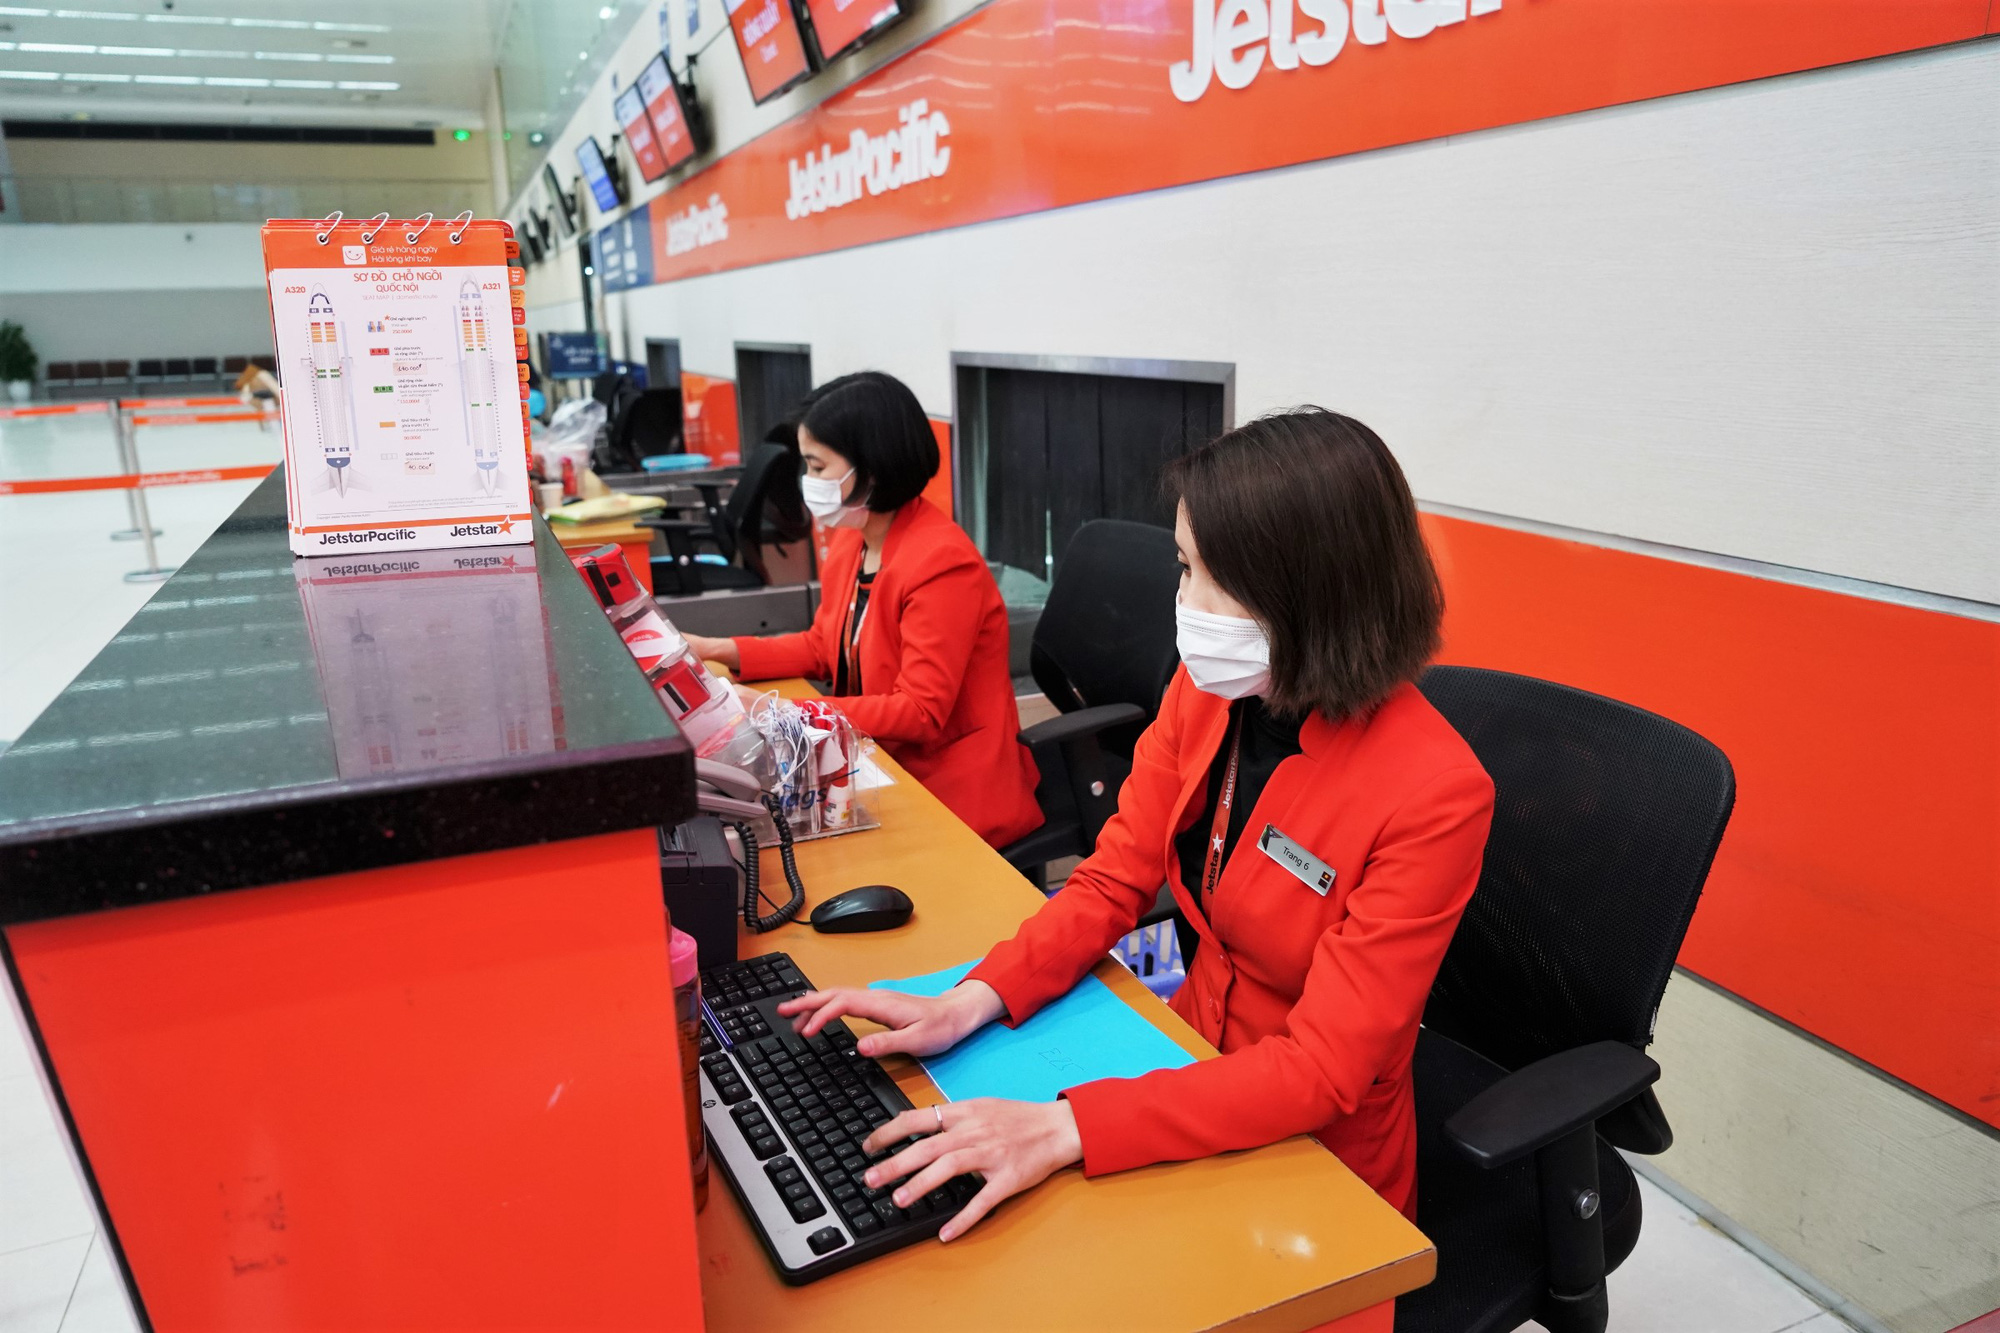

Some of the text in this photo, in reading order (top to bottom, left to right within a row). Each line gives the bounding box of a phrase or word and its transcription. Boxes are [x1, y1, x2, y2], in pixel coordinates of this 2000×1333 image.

[417, 255, 433, 264] bay
[353, 268, 442, 282] SƠ ĐỒ CHỖ NGỒI
[285, 286, 306, 294] A320
[376, 282, 419, 293] QUỐC NỘI
[482, 282, 501, 290] A321
[319, 524, 499, 545] JetstarPacific Jetstar
[1282, 846, 1310, 871] Trang 6
[1205, 850, 1220, 895] Jetstar
